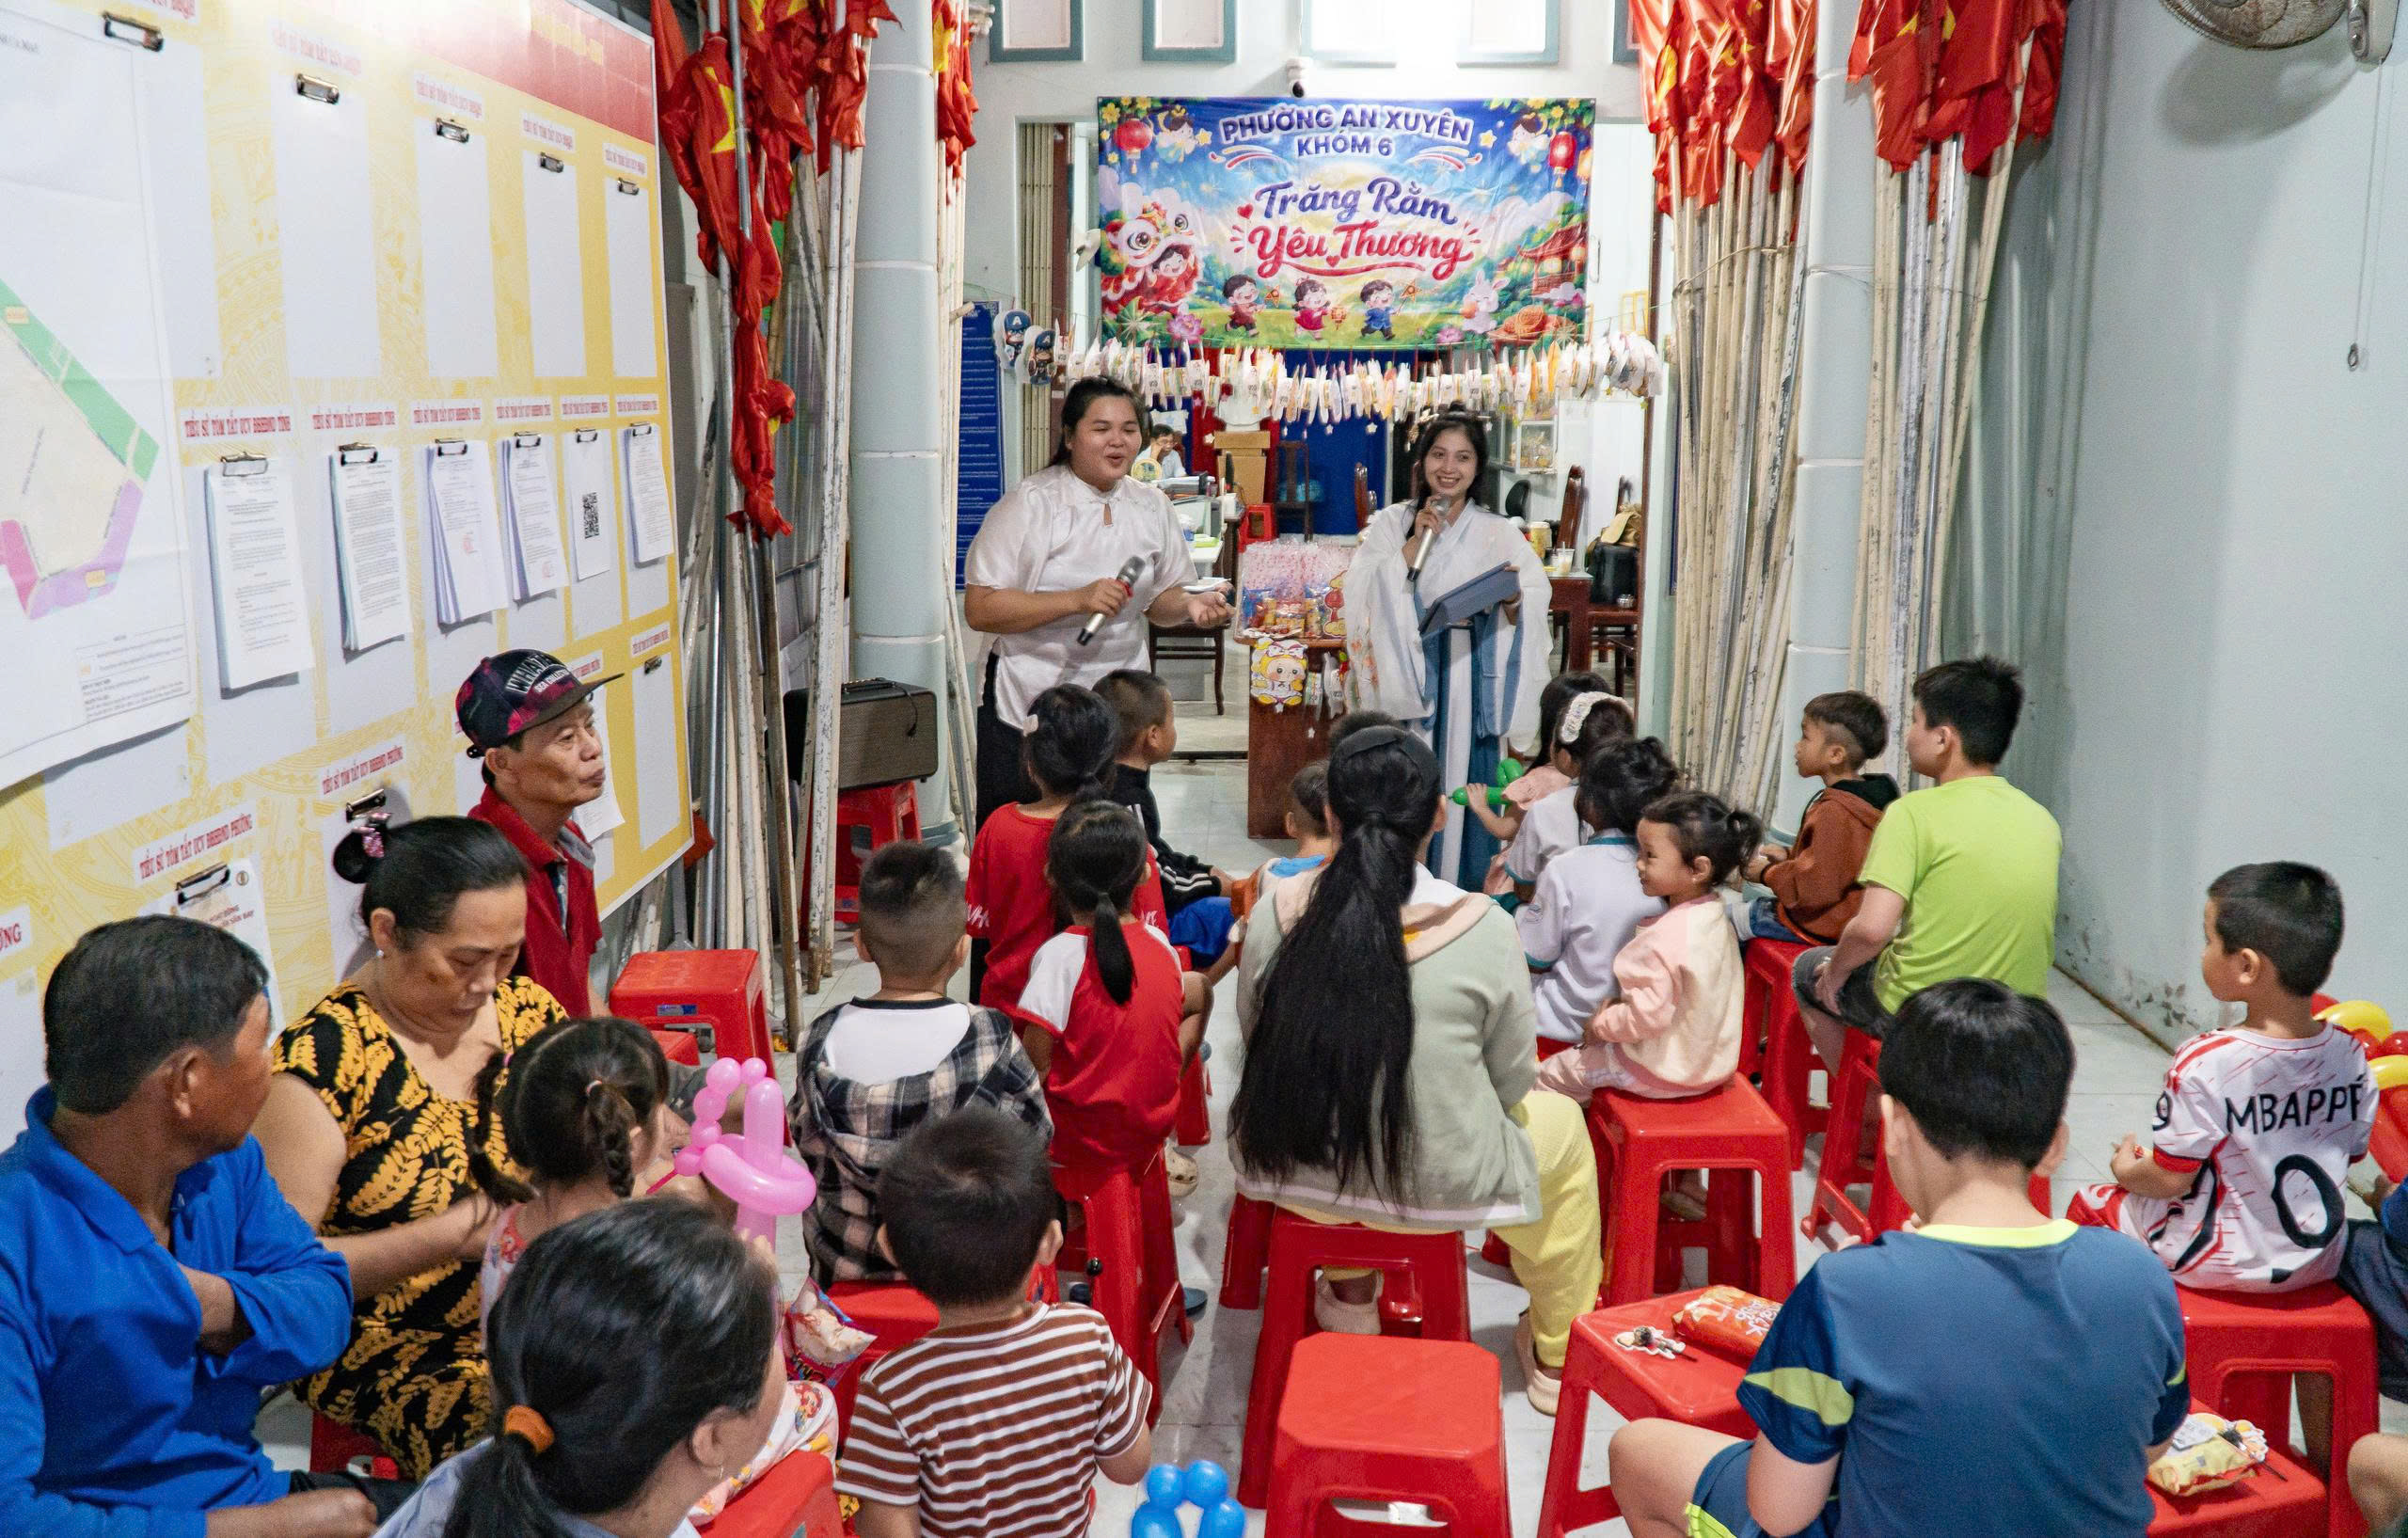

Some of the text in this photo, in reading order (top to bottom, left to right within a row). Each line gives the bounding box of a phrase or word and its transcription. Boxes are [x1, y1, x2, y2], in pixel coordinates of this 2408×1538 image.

[1222, 106, 1471, 141] PHƯỜNG AN XUYÊN
[1297, 130, 1393, 157] KHÓM 6
[1255, 177, 1458, 225] Trăng Rằm
[1248, 219, 1474, 280] Yêu Thương
